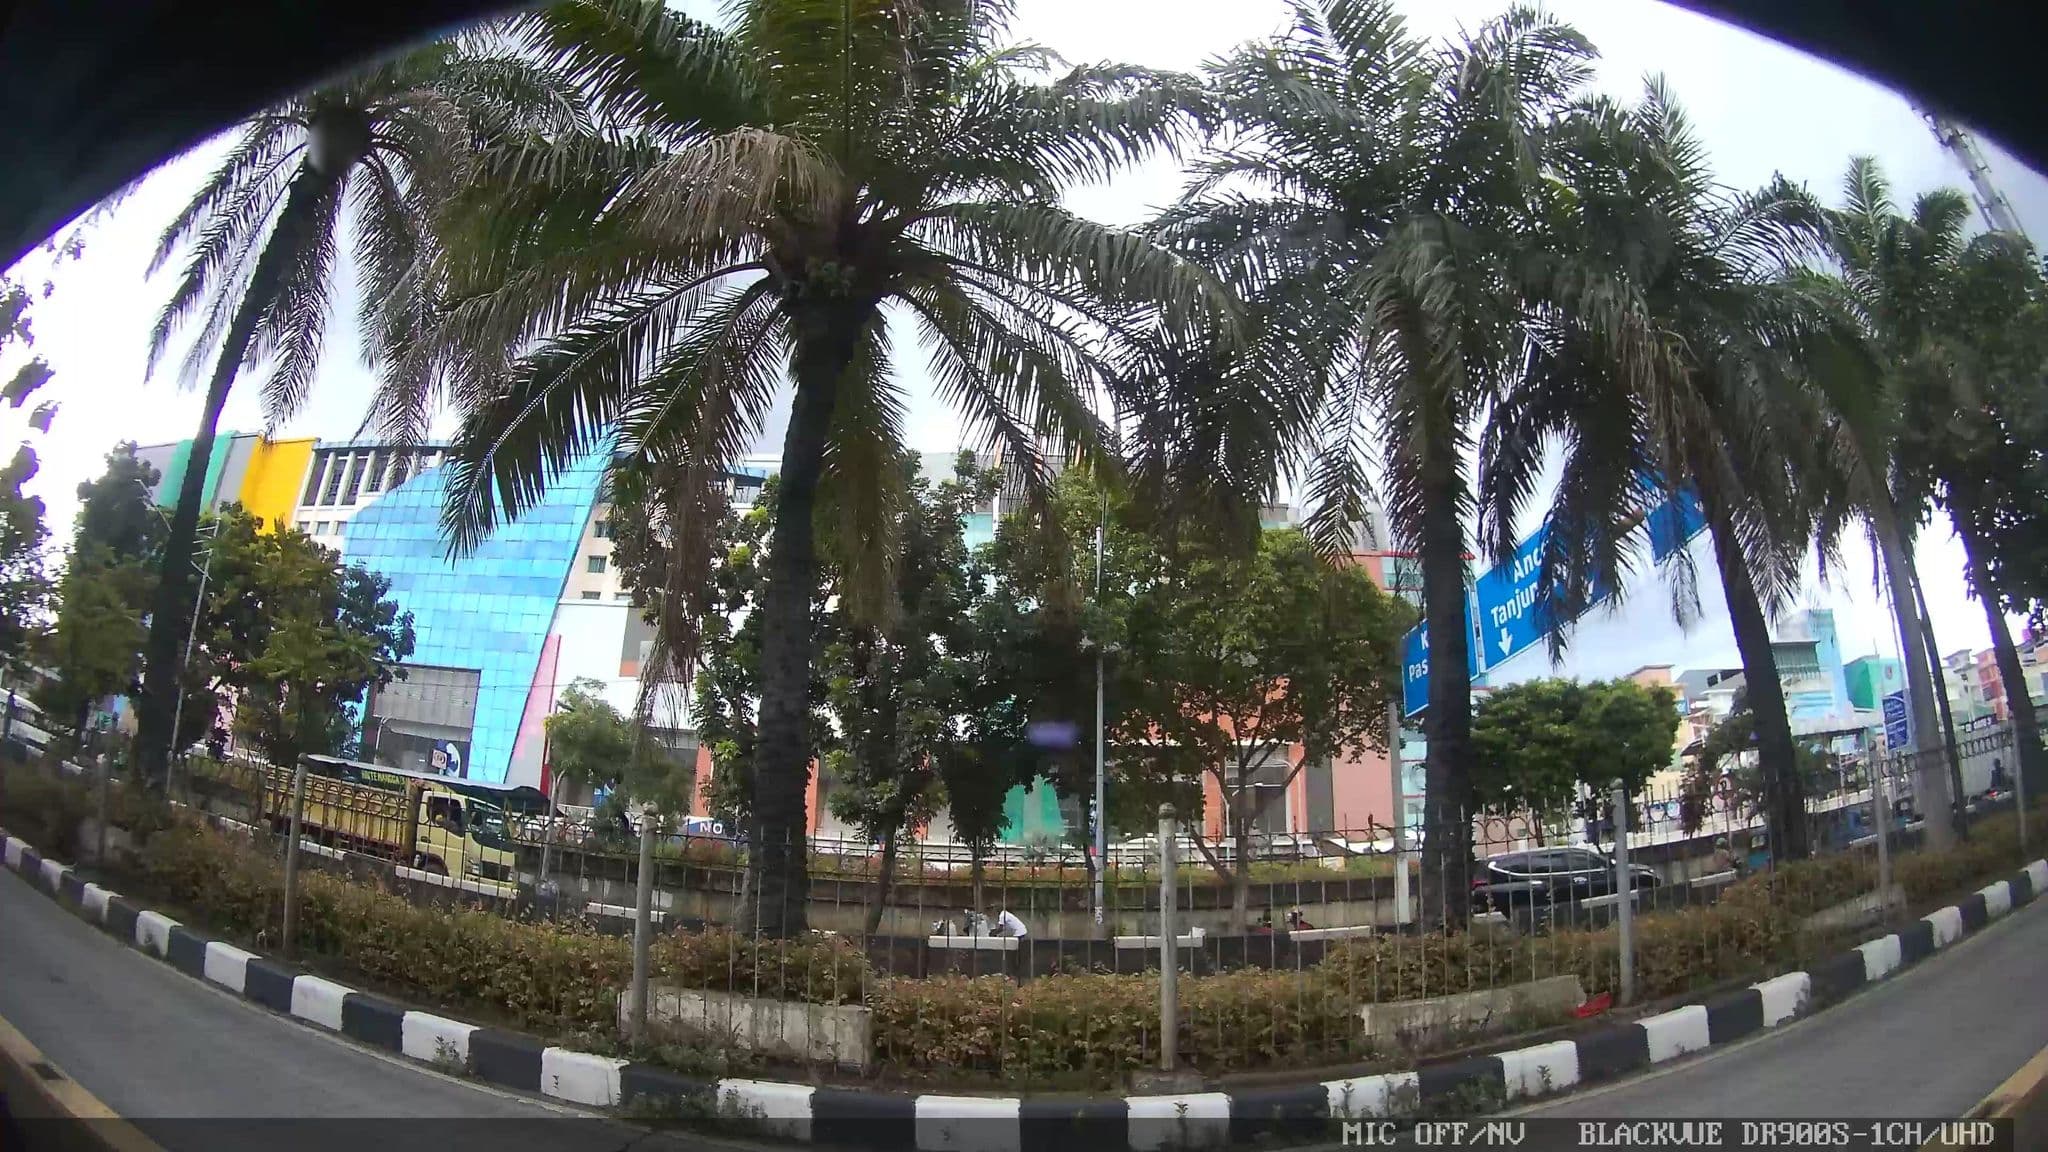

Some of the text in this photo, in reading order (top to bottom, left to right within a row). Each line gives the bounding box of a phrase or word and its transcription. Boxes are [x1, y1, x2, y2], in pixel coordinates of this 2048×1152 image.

[1514, 546, 1543, 584] Anc
[1420, 629, 1429, 651] K
[1408, 658, 1429, 683] Pas
